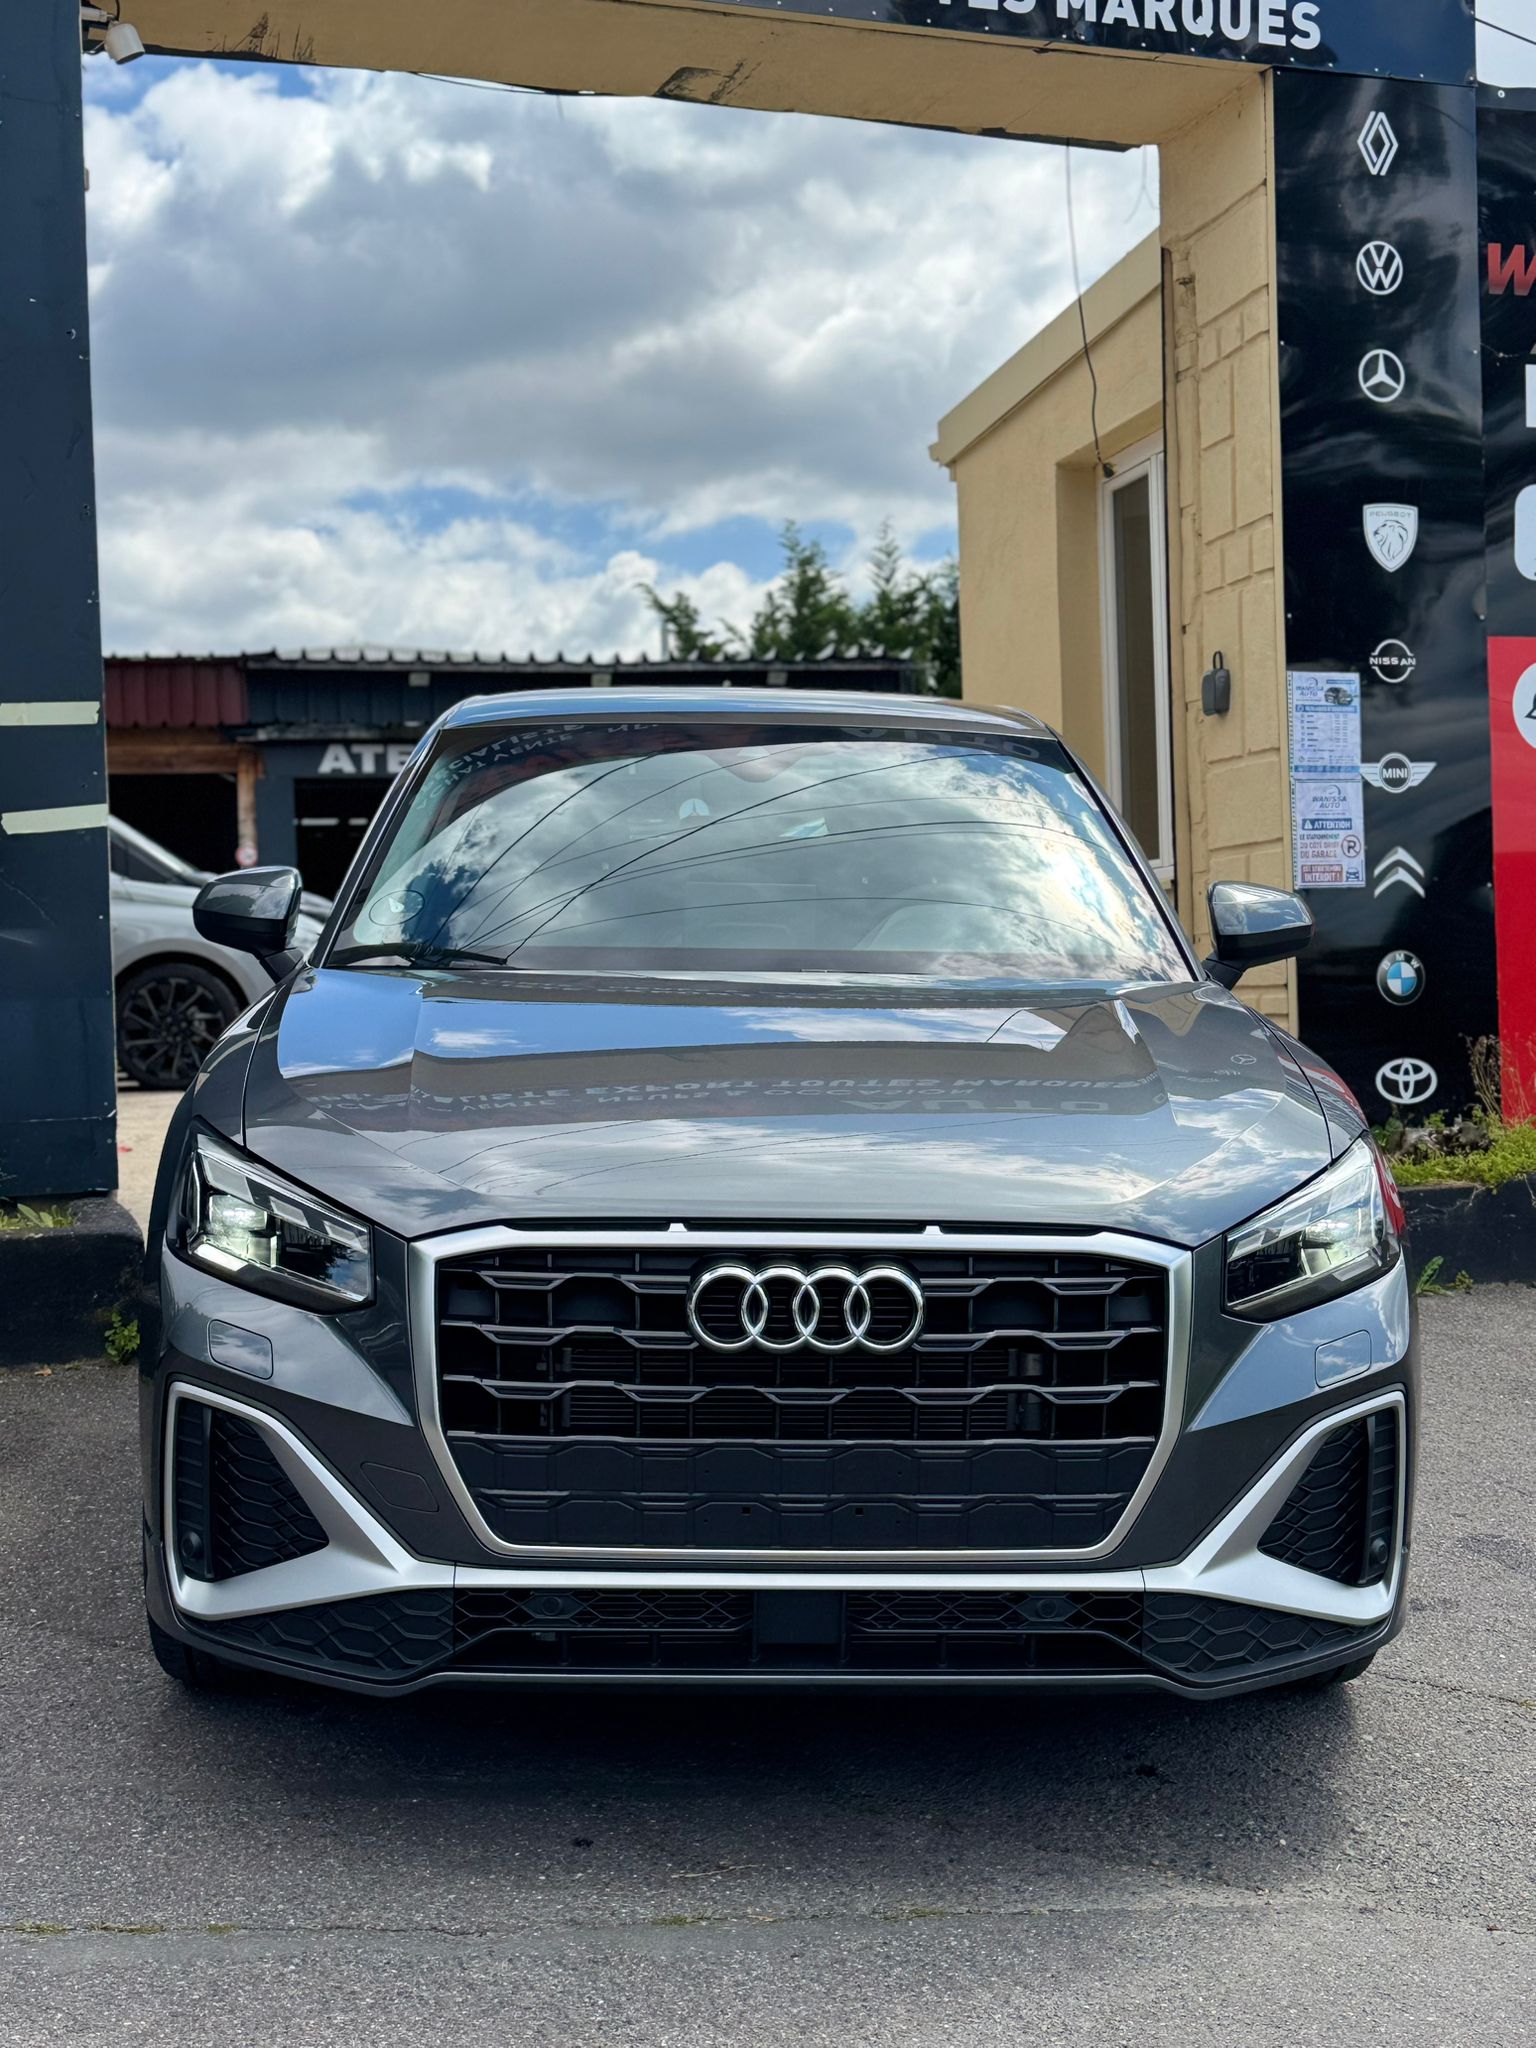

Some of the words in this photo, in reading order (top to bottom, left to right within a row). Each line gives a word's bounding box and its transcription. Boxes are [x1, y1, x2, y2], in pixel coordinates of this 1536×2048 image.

[1369, 656, 1416, 666] NISSAN
[1382, 768, 1408, 779] MINI
[1313, 820, 1351, 830] ATTENTION
